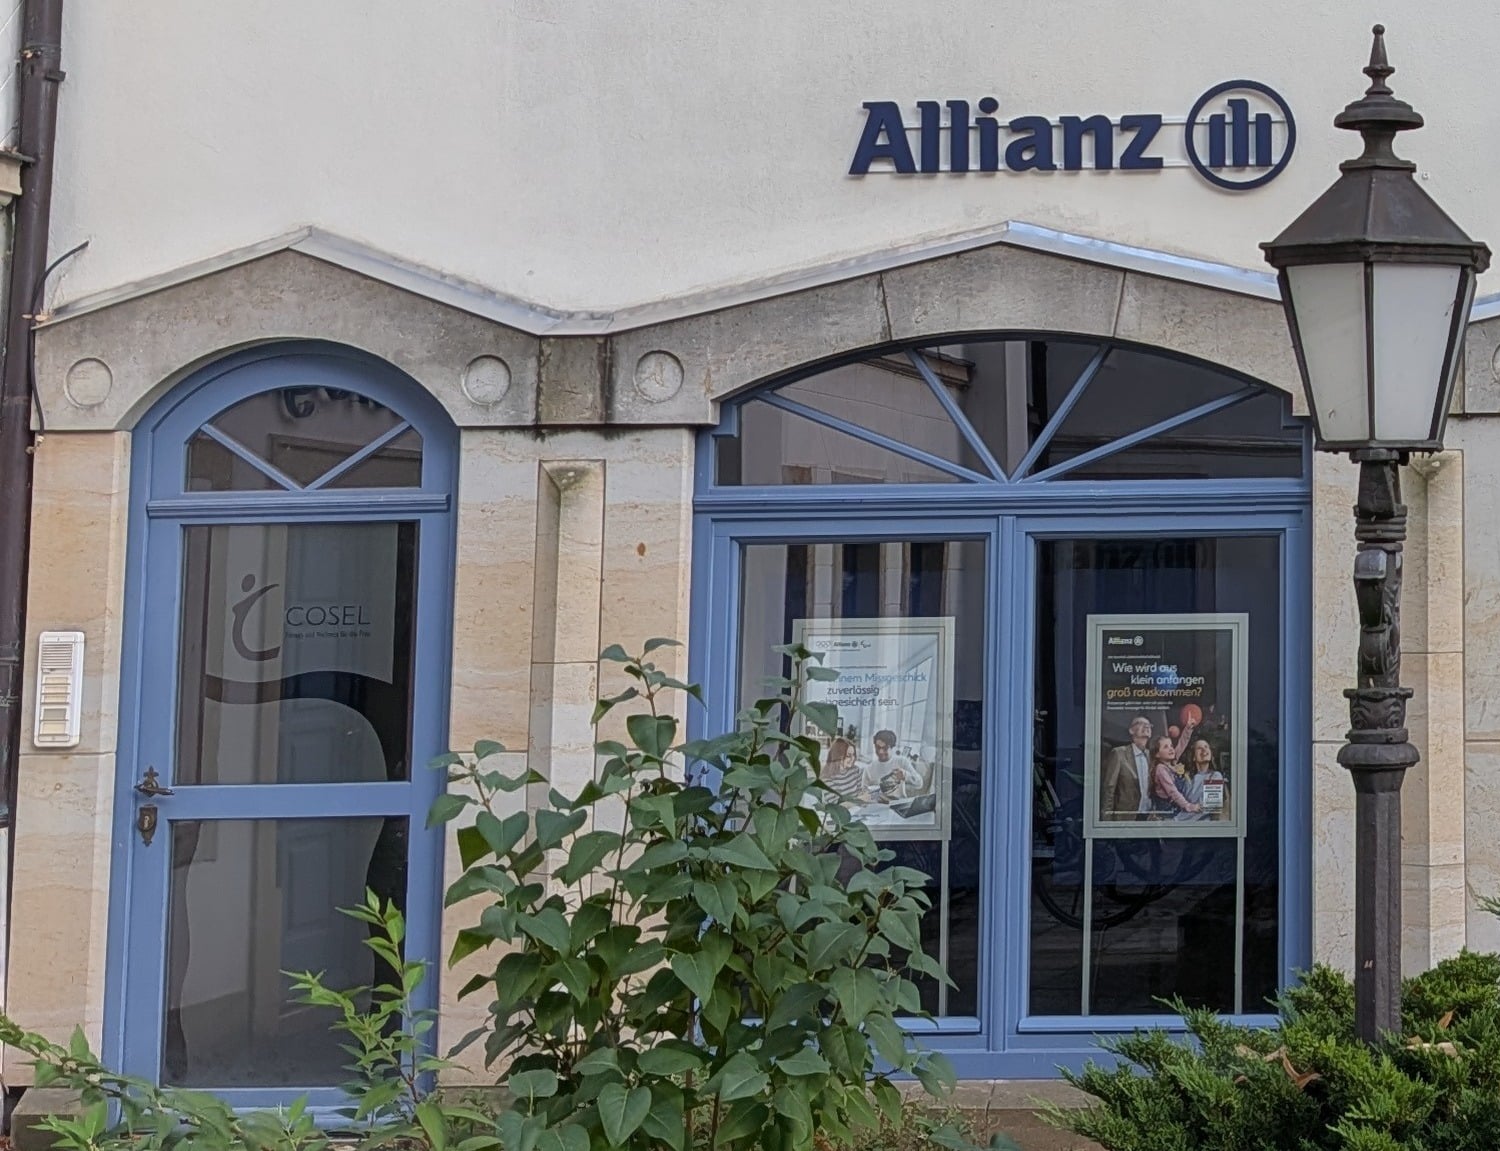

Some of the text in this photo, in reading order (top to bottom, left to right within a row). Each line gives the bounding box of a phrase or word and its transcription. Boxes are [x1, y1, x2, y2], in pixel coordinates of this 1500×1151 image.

[849, 97, 1163, 175] Allianz
[286, 606, 371, 627] COSEL
[1112, 662, 1178, 673] Wie wird aus
[865, 672, 927, 684] Missgeschick
[1130, 674, 1205, 687] klein anfangen
[827, 685, 880, 697] zuverlässig
[1106, 686, 1203, 699] groß rauskommen?
